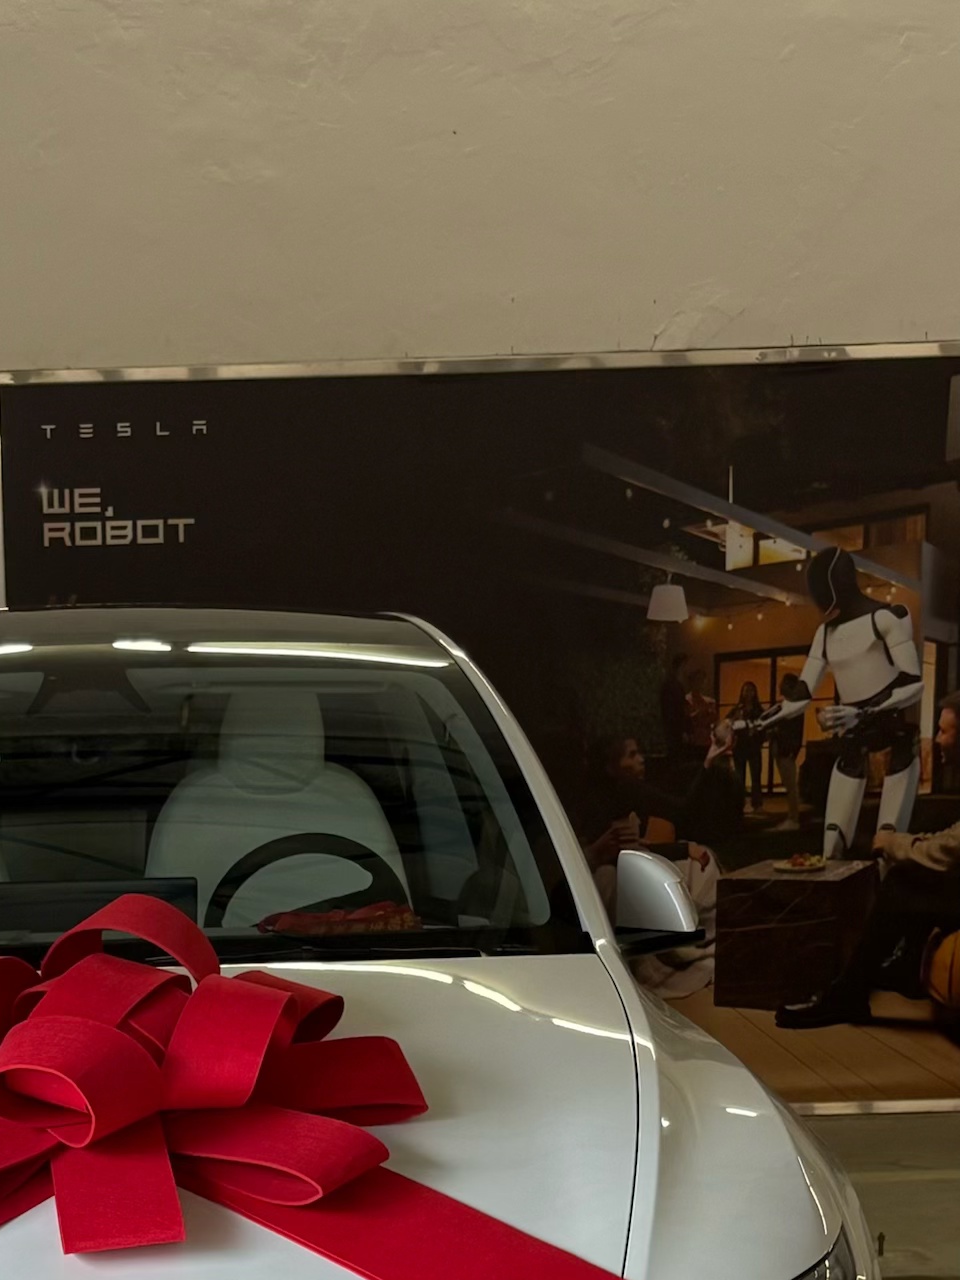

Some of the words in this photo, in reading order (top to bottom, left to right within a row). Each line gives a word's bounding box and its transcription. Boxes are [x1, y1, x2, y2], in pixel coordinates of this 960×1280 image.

[41, 420, 207, 440] TESLA
[41, 487, 114, 517] WE,
[43, 518, 196, 547] ROBOT
